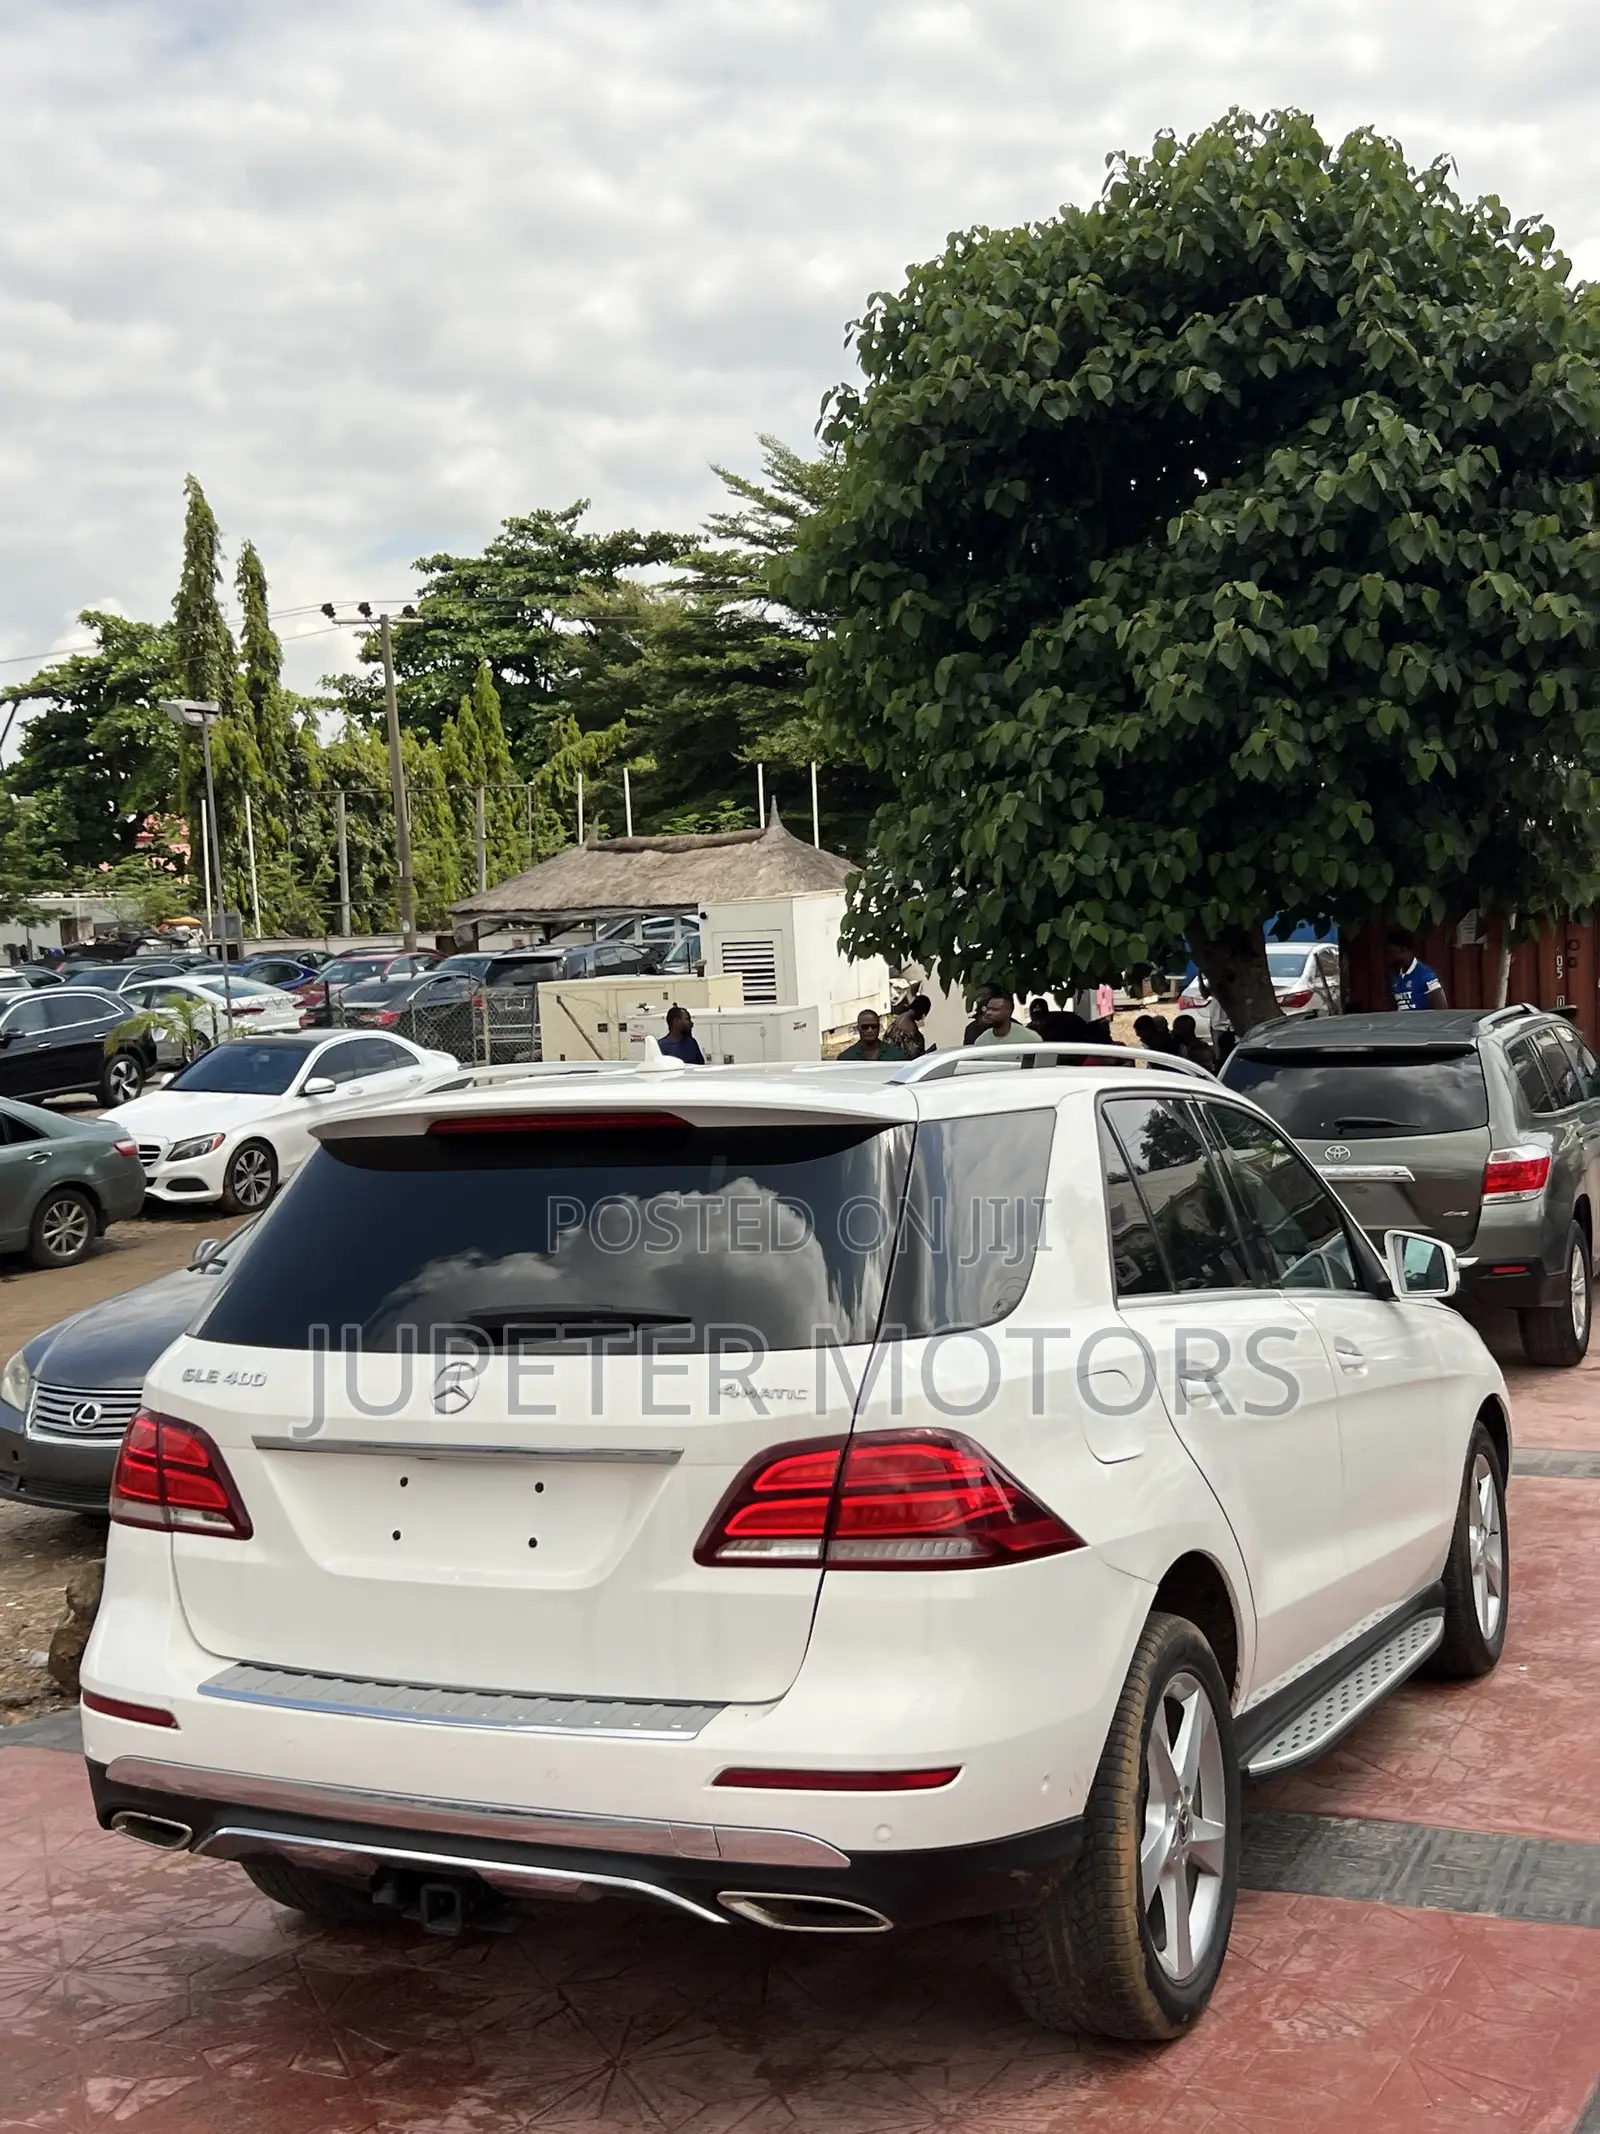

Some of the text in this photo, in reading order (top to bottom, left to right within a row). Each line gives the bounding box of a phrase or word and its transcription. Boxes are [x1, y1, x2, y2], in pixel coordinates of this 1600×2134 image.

[182, 1368, 268, 1387] GLE 400
[718, 1383, 808, 1400] 4MATIC
